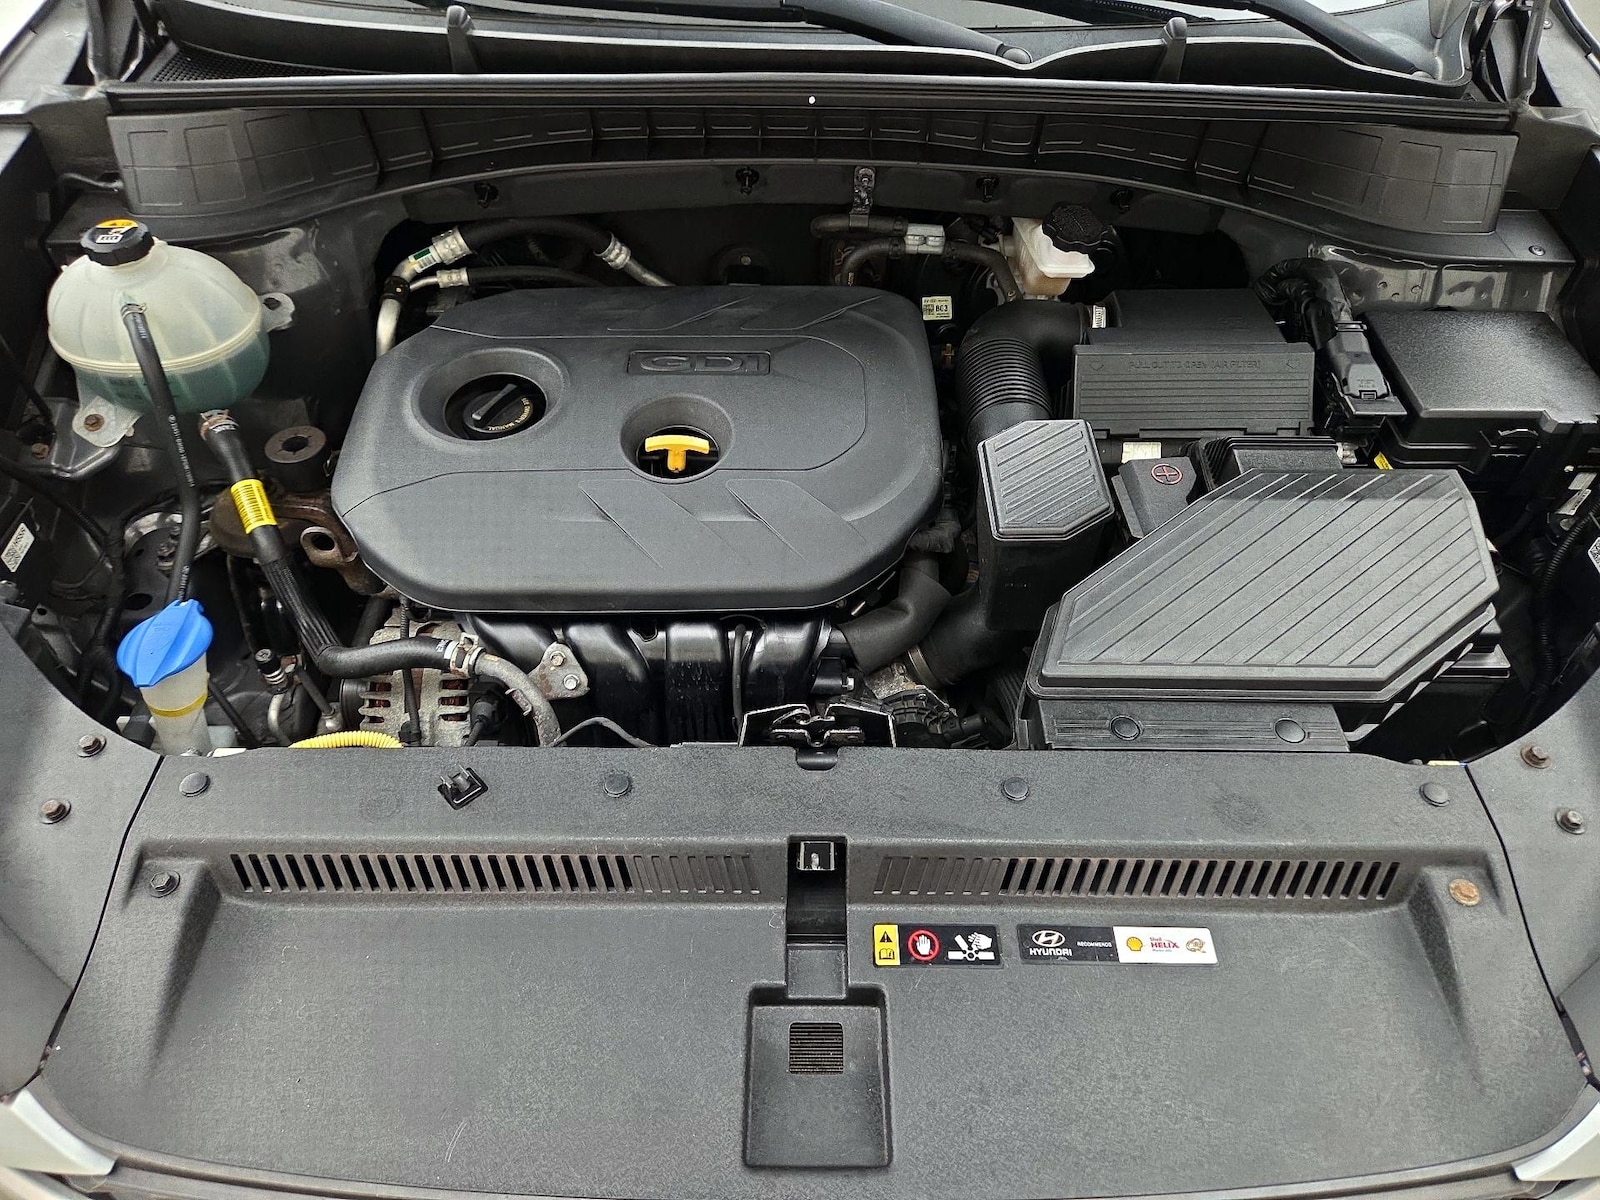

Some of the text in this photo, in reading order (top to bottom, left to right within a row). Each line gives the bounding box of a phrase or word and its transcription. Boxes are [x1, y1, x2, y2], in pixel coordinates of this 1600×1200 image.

[640, 355, 760, 372] GDI
[1129, 360, 1151, 369] PULL
[1151, 360, 1169, 369] OUT
[1170, 360, 1181, 369] TO
[1185, 360, 1207, 370] OPEN
[488, 422, 515, 431] MANUAL
[1150, 941, 1180, 949] HELIX
[1029, 947, 1073, 956] HYUNDAI
